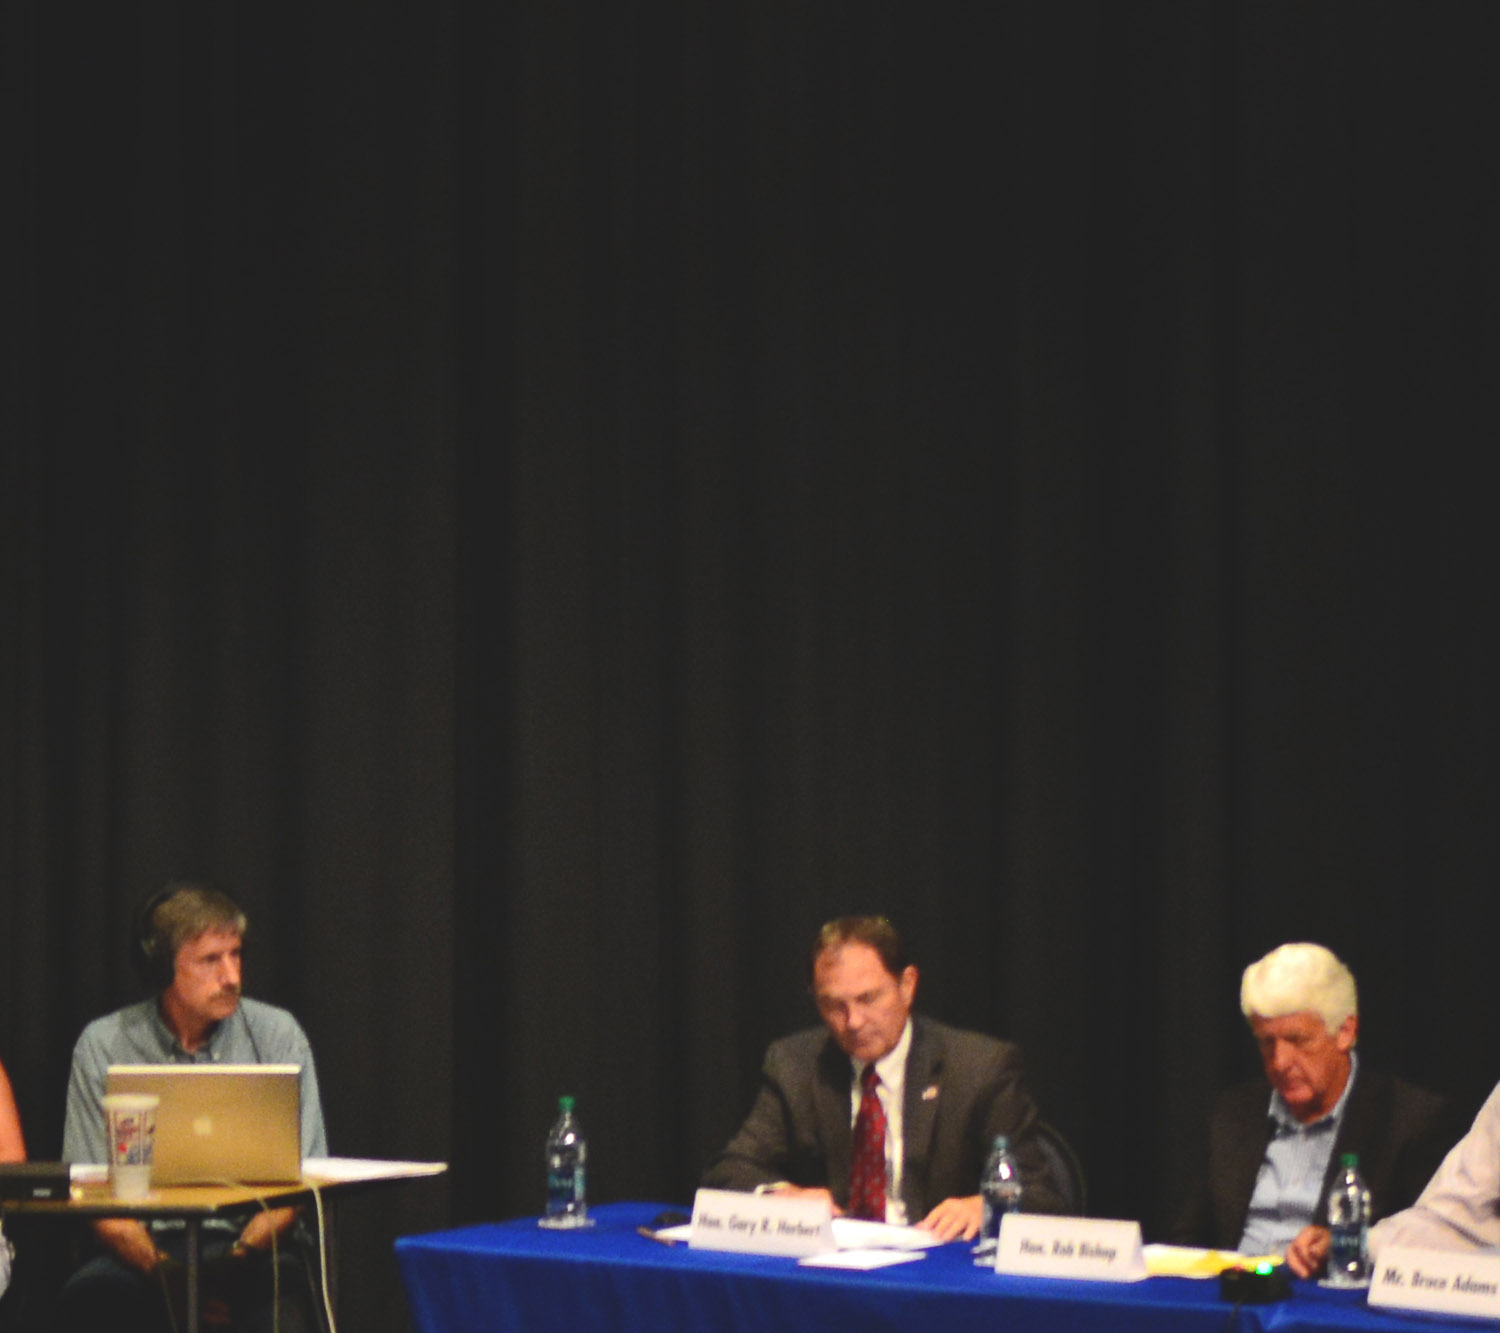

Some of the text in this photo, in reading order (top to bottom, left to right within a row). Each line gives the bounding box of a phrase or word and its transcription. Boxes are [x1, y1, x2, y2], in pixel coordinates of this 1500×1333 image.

[728, 1215, 756, 1236] Gary
[777, 1220, 821, 1237] Herbert
[1052, 1240, 1074, 1256] Rob
[1079, 1243, 1116, 1263] Bishop
[1382, 1268, 1498, 1295] Mr. Bruce Adams
